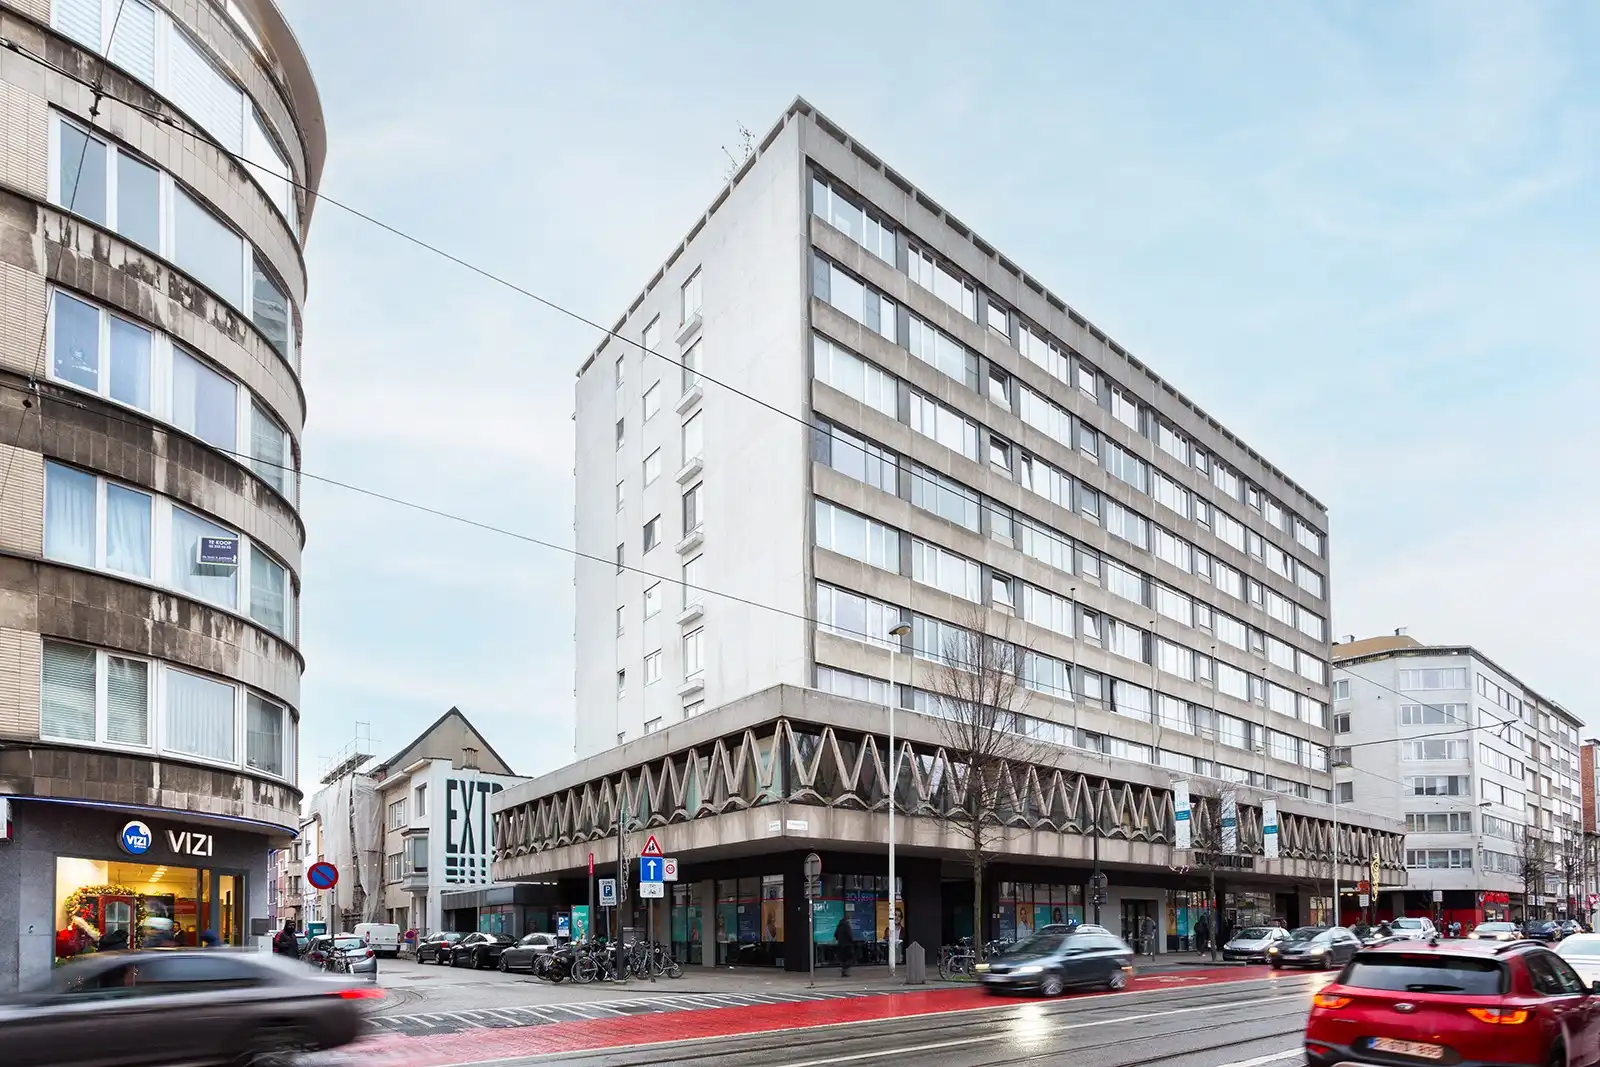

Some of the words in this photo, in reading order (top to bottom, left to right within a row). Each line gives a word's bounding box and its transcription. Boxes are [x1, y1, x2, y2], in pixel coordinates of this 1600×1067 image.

[126, 834, 147, 846] VIZI
[167, 829, 213, 857] VIZI
[605, 886, 610, 894] P
[558, 916, 564, 925] P
